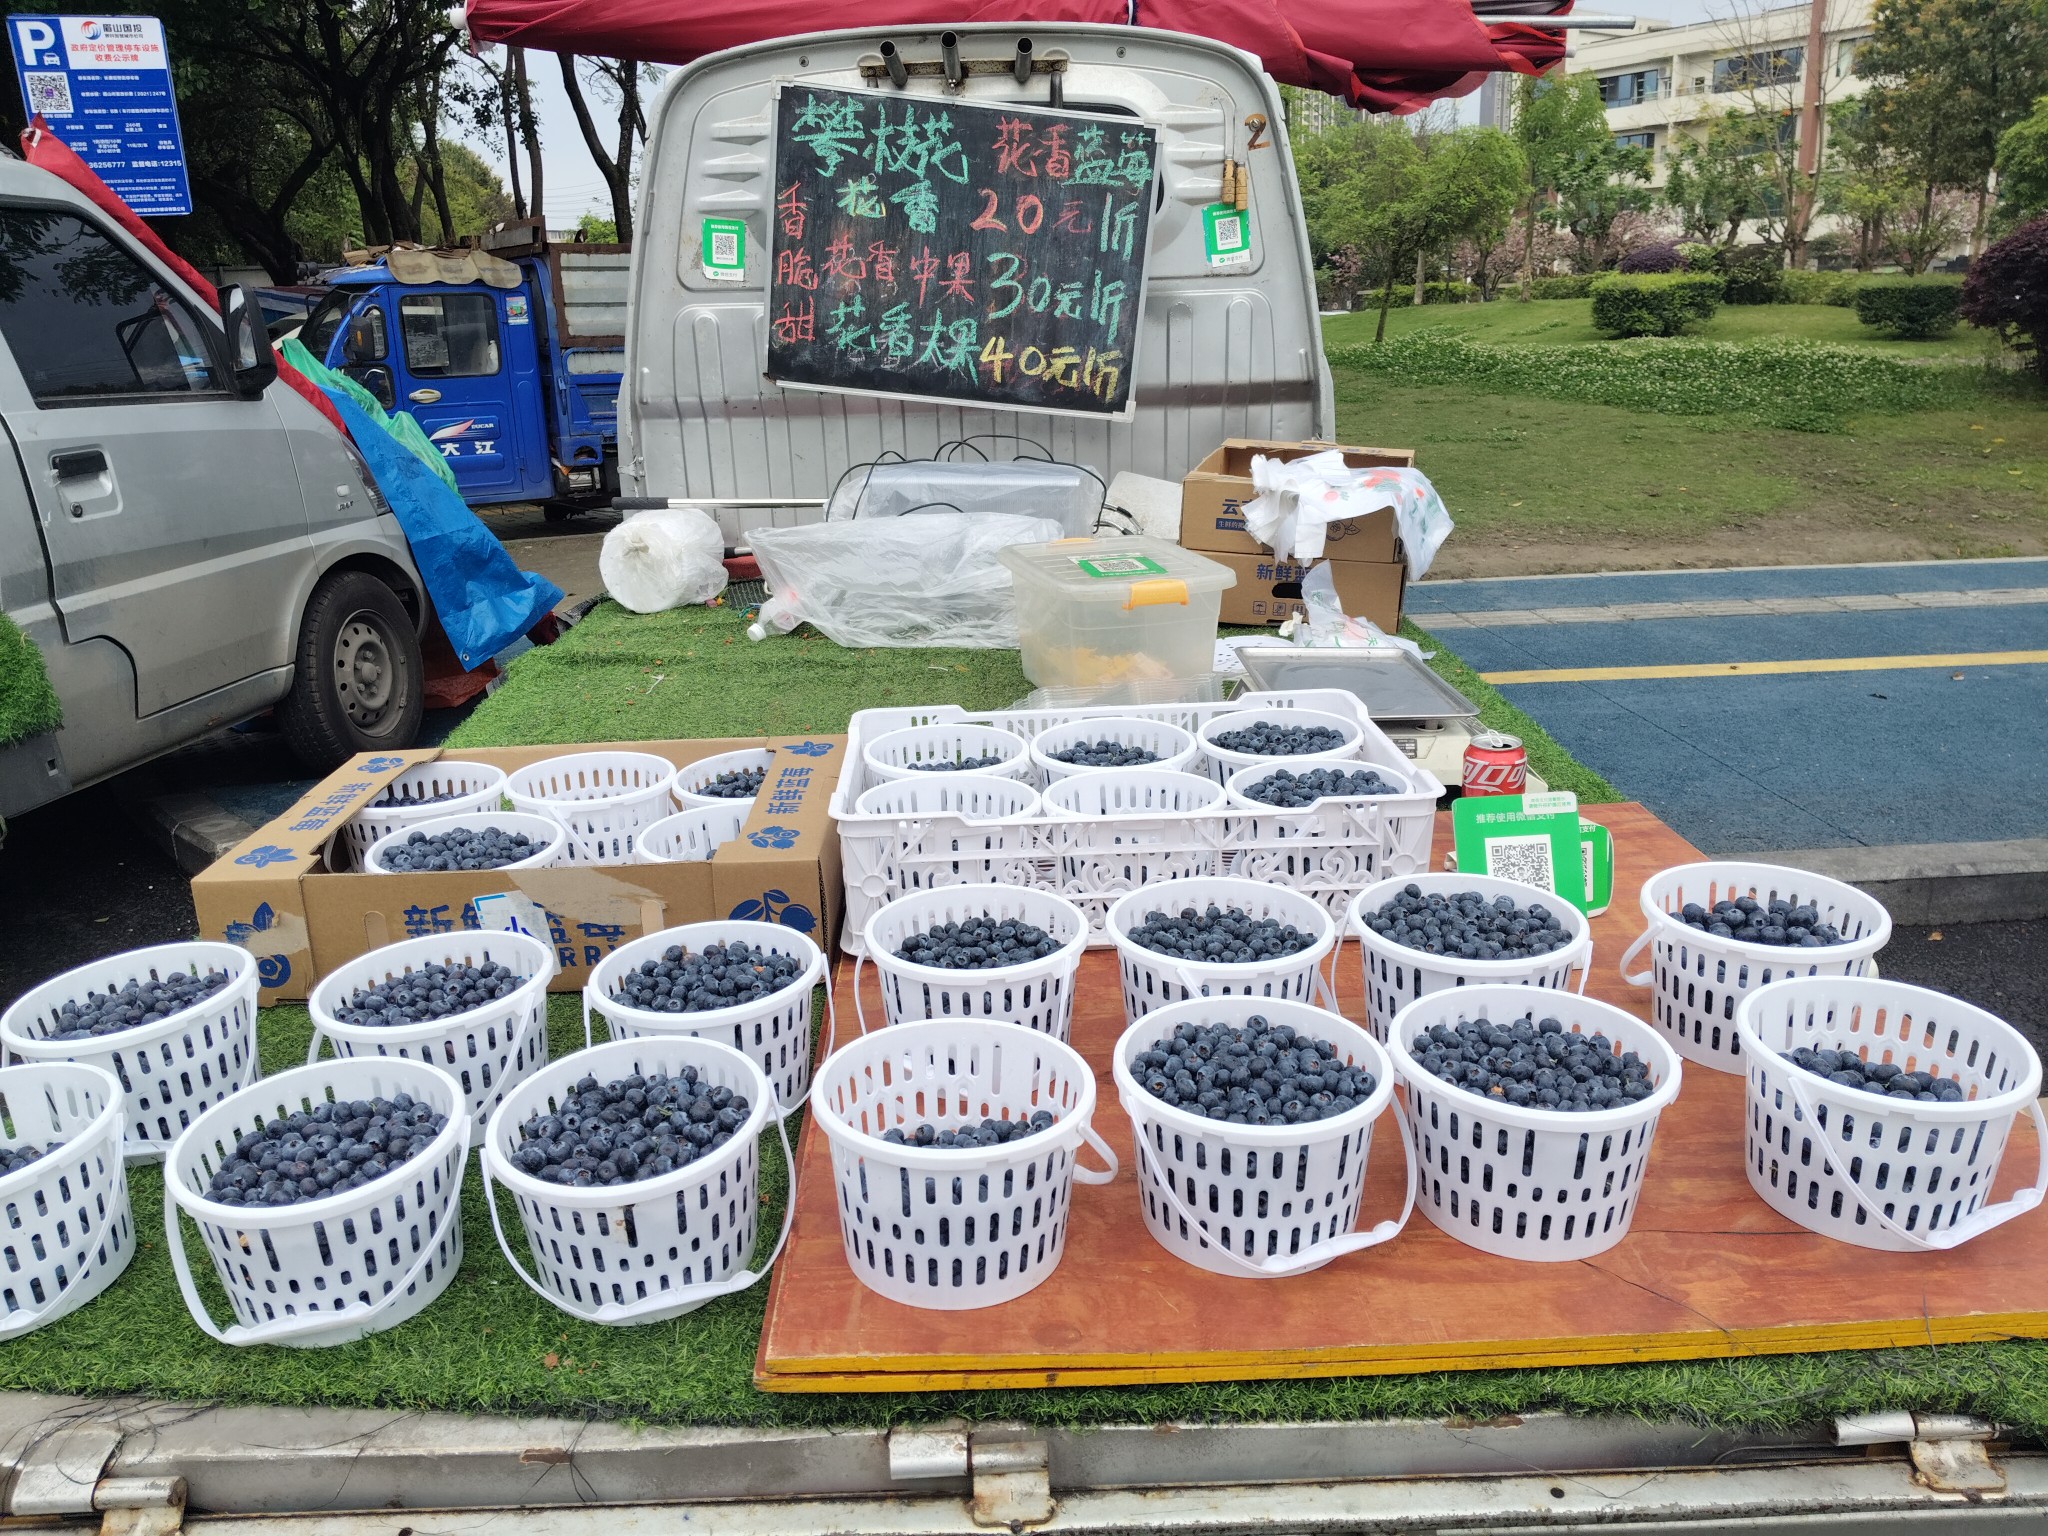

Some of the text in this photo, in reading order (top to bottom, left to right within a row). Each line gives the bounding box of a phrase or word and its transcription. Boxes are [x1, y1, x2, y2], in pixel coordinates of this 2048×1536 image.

[15, 21, 55, 66] P
[71, 43, 160, 52] 政府定价管理停车设施
[440, 441, 496, 456] 大江
